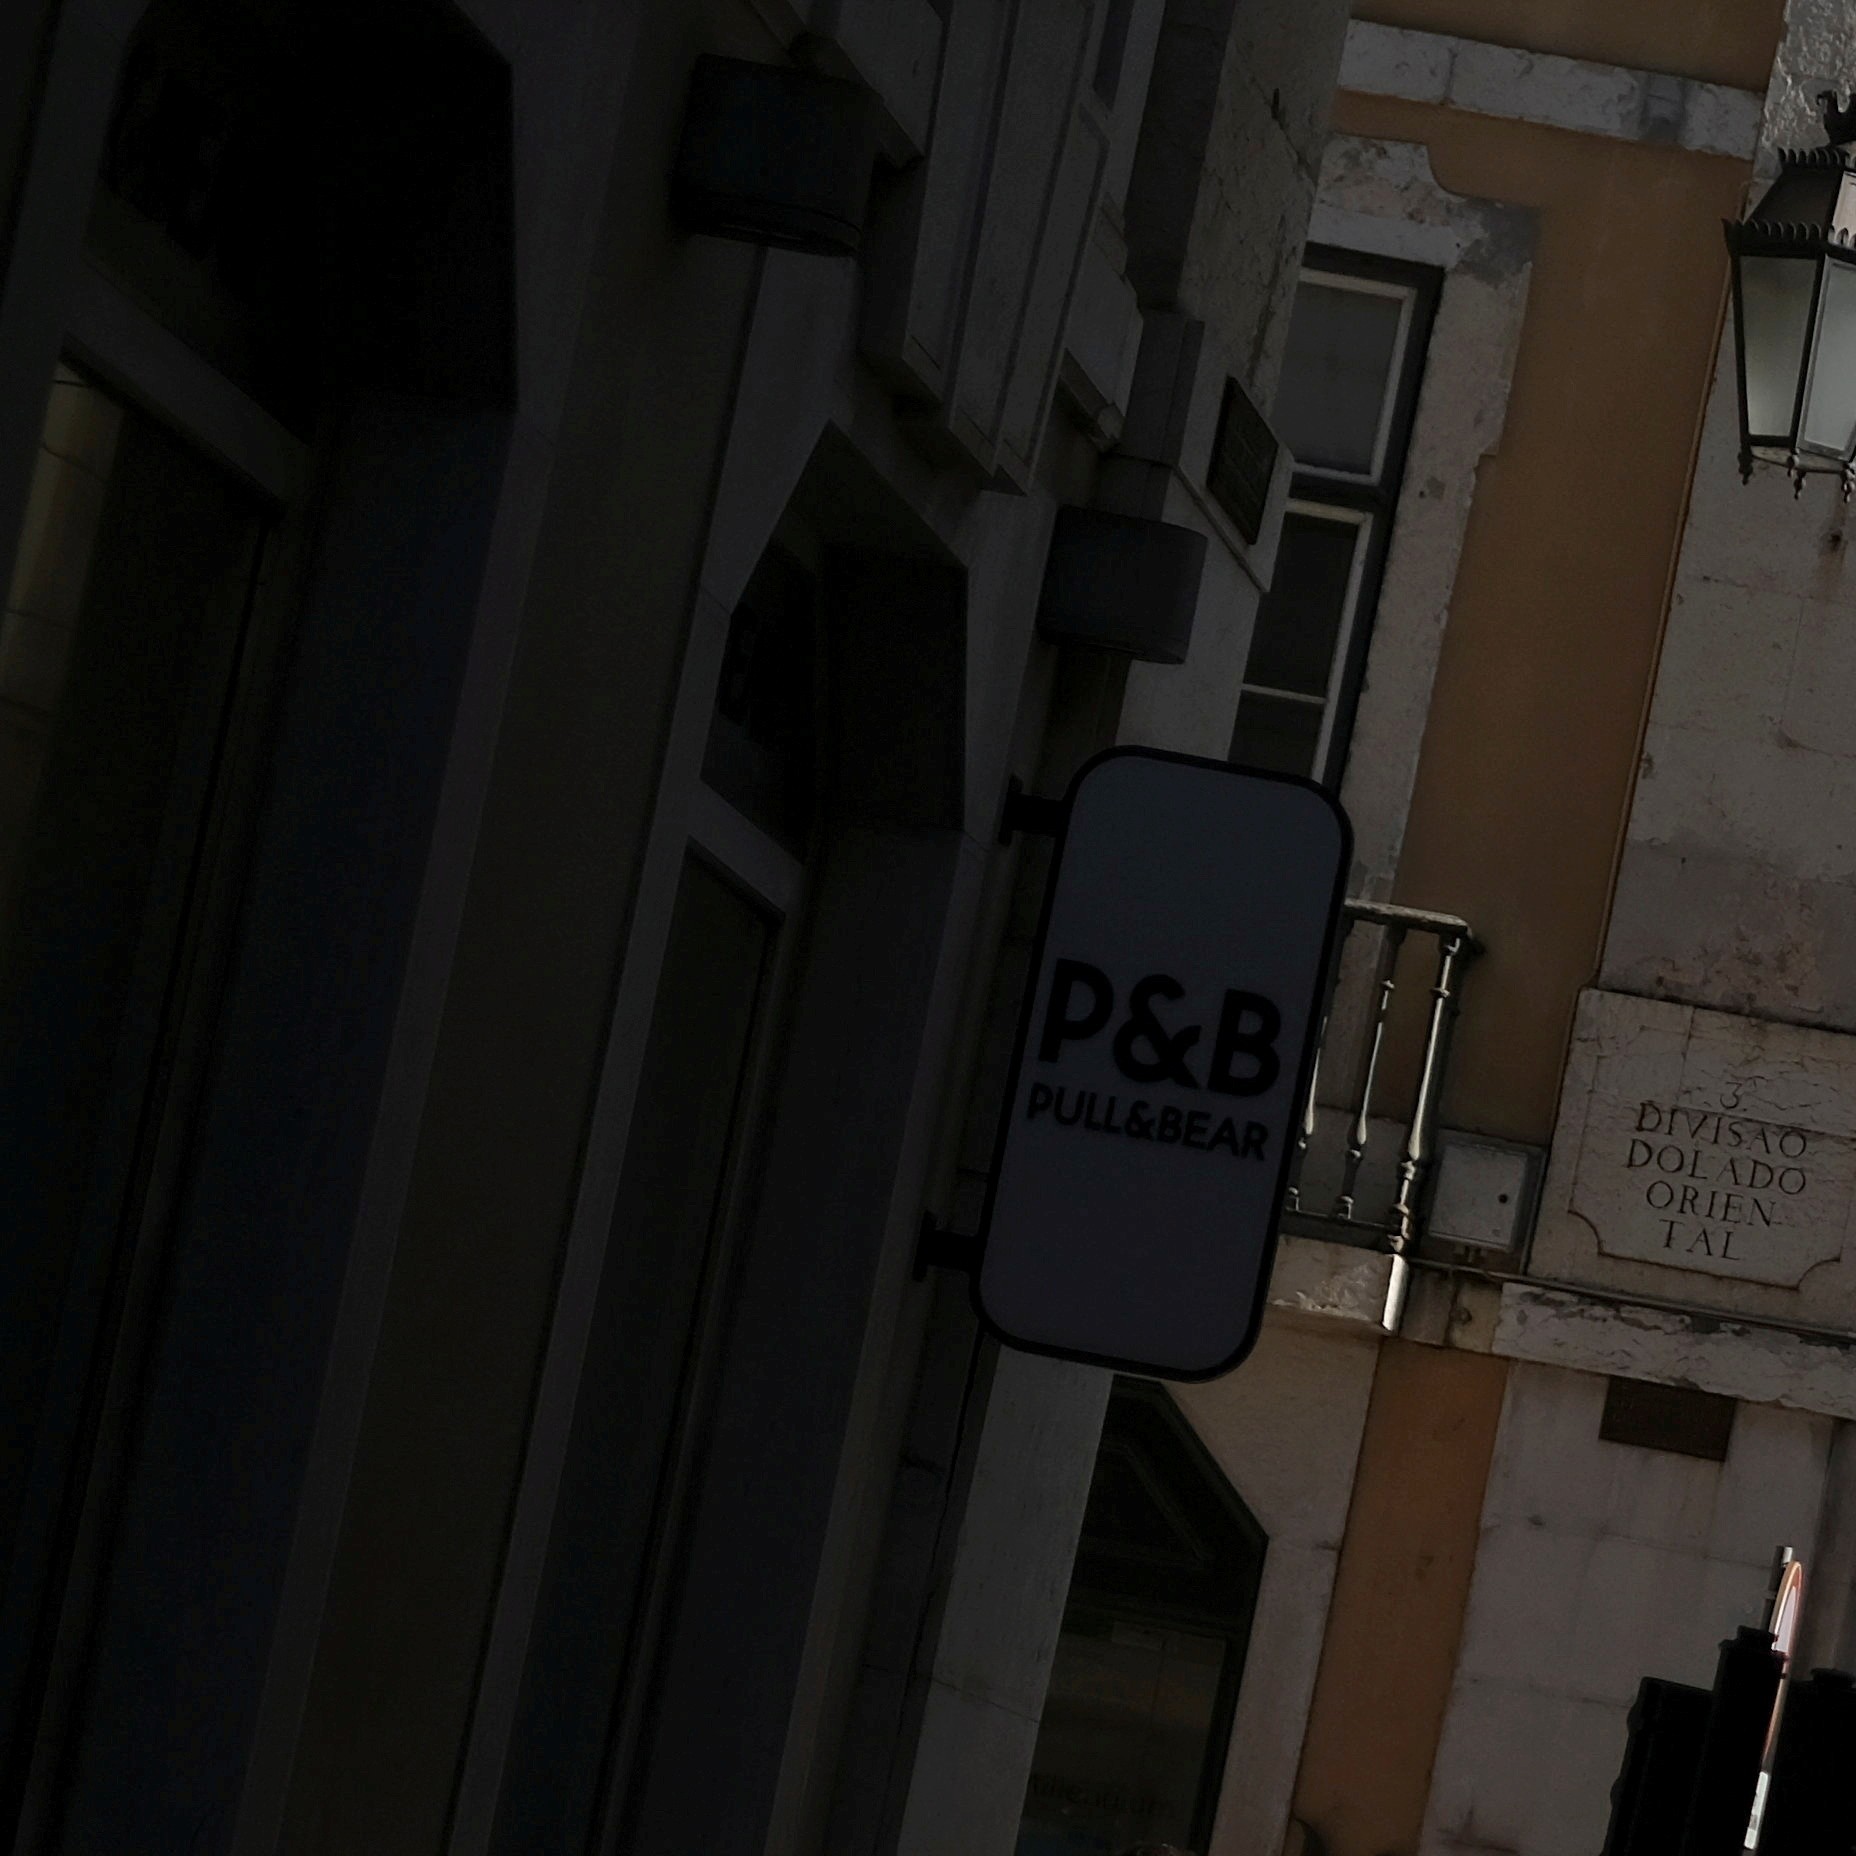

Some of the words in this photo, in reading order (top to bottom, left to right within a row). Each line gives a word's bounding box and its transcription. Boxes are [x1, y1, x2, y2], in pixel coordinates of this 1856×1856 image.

[1038, 957, 1282, 1097] P&B
[1027, 1083, 1268, 1161] PULL&BEAR
[1658, 1219, 1741, 1262] TAL
